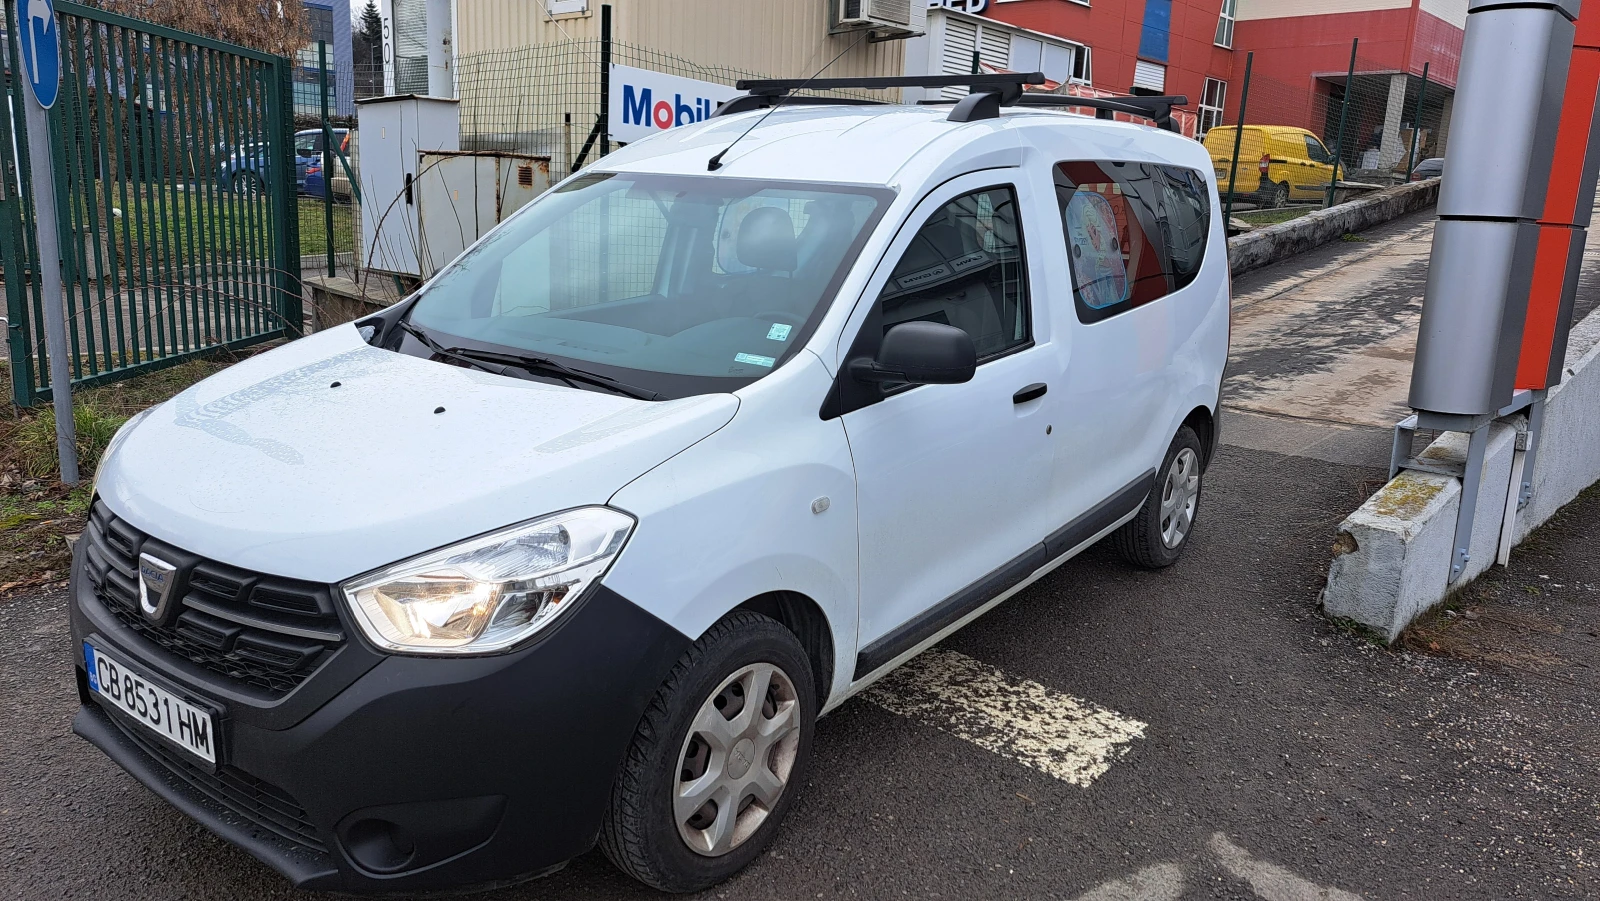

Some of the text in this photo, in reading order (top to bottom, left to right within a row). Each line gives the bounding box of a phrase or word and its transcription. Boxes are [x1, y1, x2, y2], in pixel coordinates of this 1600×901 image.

[622, 84, 711, 130] Mobil
[141, 565, 164, 582] DACIA
[98, 656, 210, 755] CB 8531 HM
